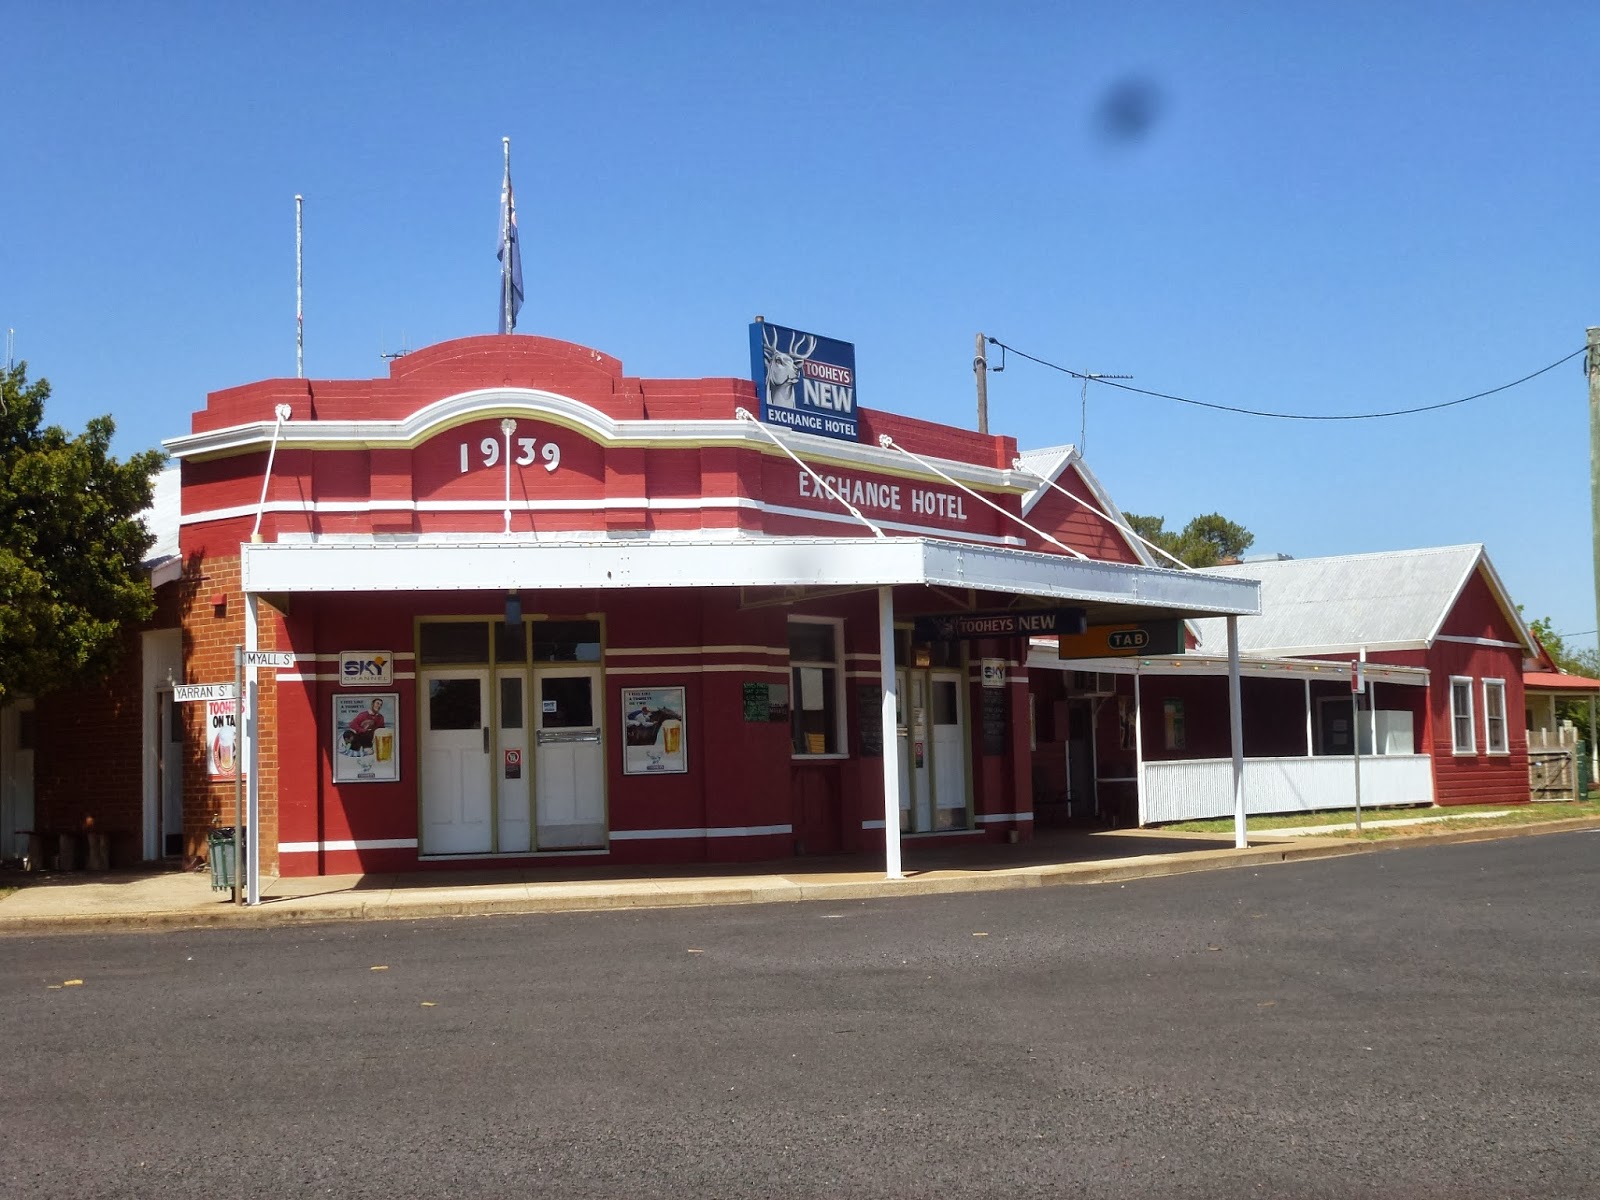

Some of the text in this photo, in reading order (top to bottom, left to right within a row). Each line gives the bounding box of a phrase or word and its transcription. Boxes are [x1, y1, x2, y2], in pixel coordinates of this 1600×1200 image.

[805, 360, 851, 384] TOOHEYS
[803, 378, 853, 414] NEW
[767, 408, 857, 437] EXCHANGE HOTEL
[460, 437, 561, 473] 1939
[799, 471, 968, 520] EXCHANGE HOTEL
[960, 614, 1057, 634] TOOHEYS NEW
[1113, 633, 1144, 646] TAB
[247, 653, 280, 665] MYALL
[344, 660, 388, 676] SKY
[176, 686, 213, 699] YARRAN
[213, 715, 224, 728] ON
